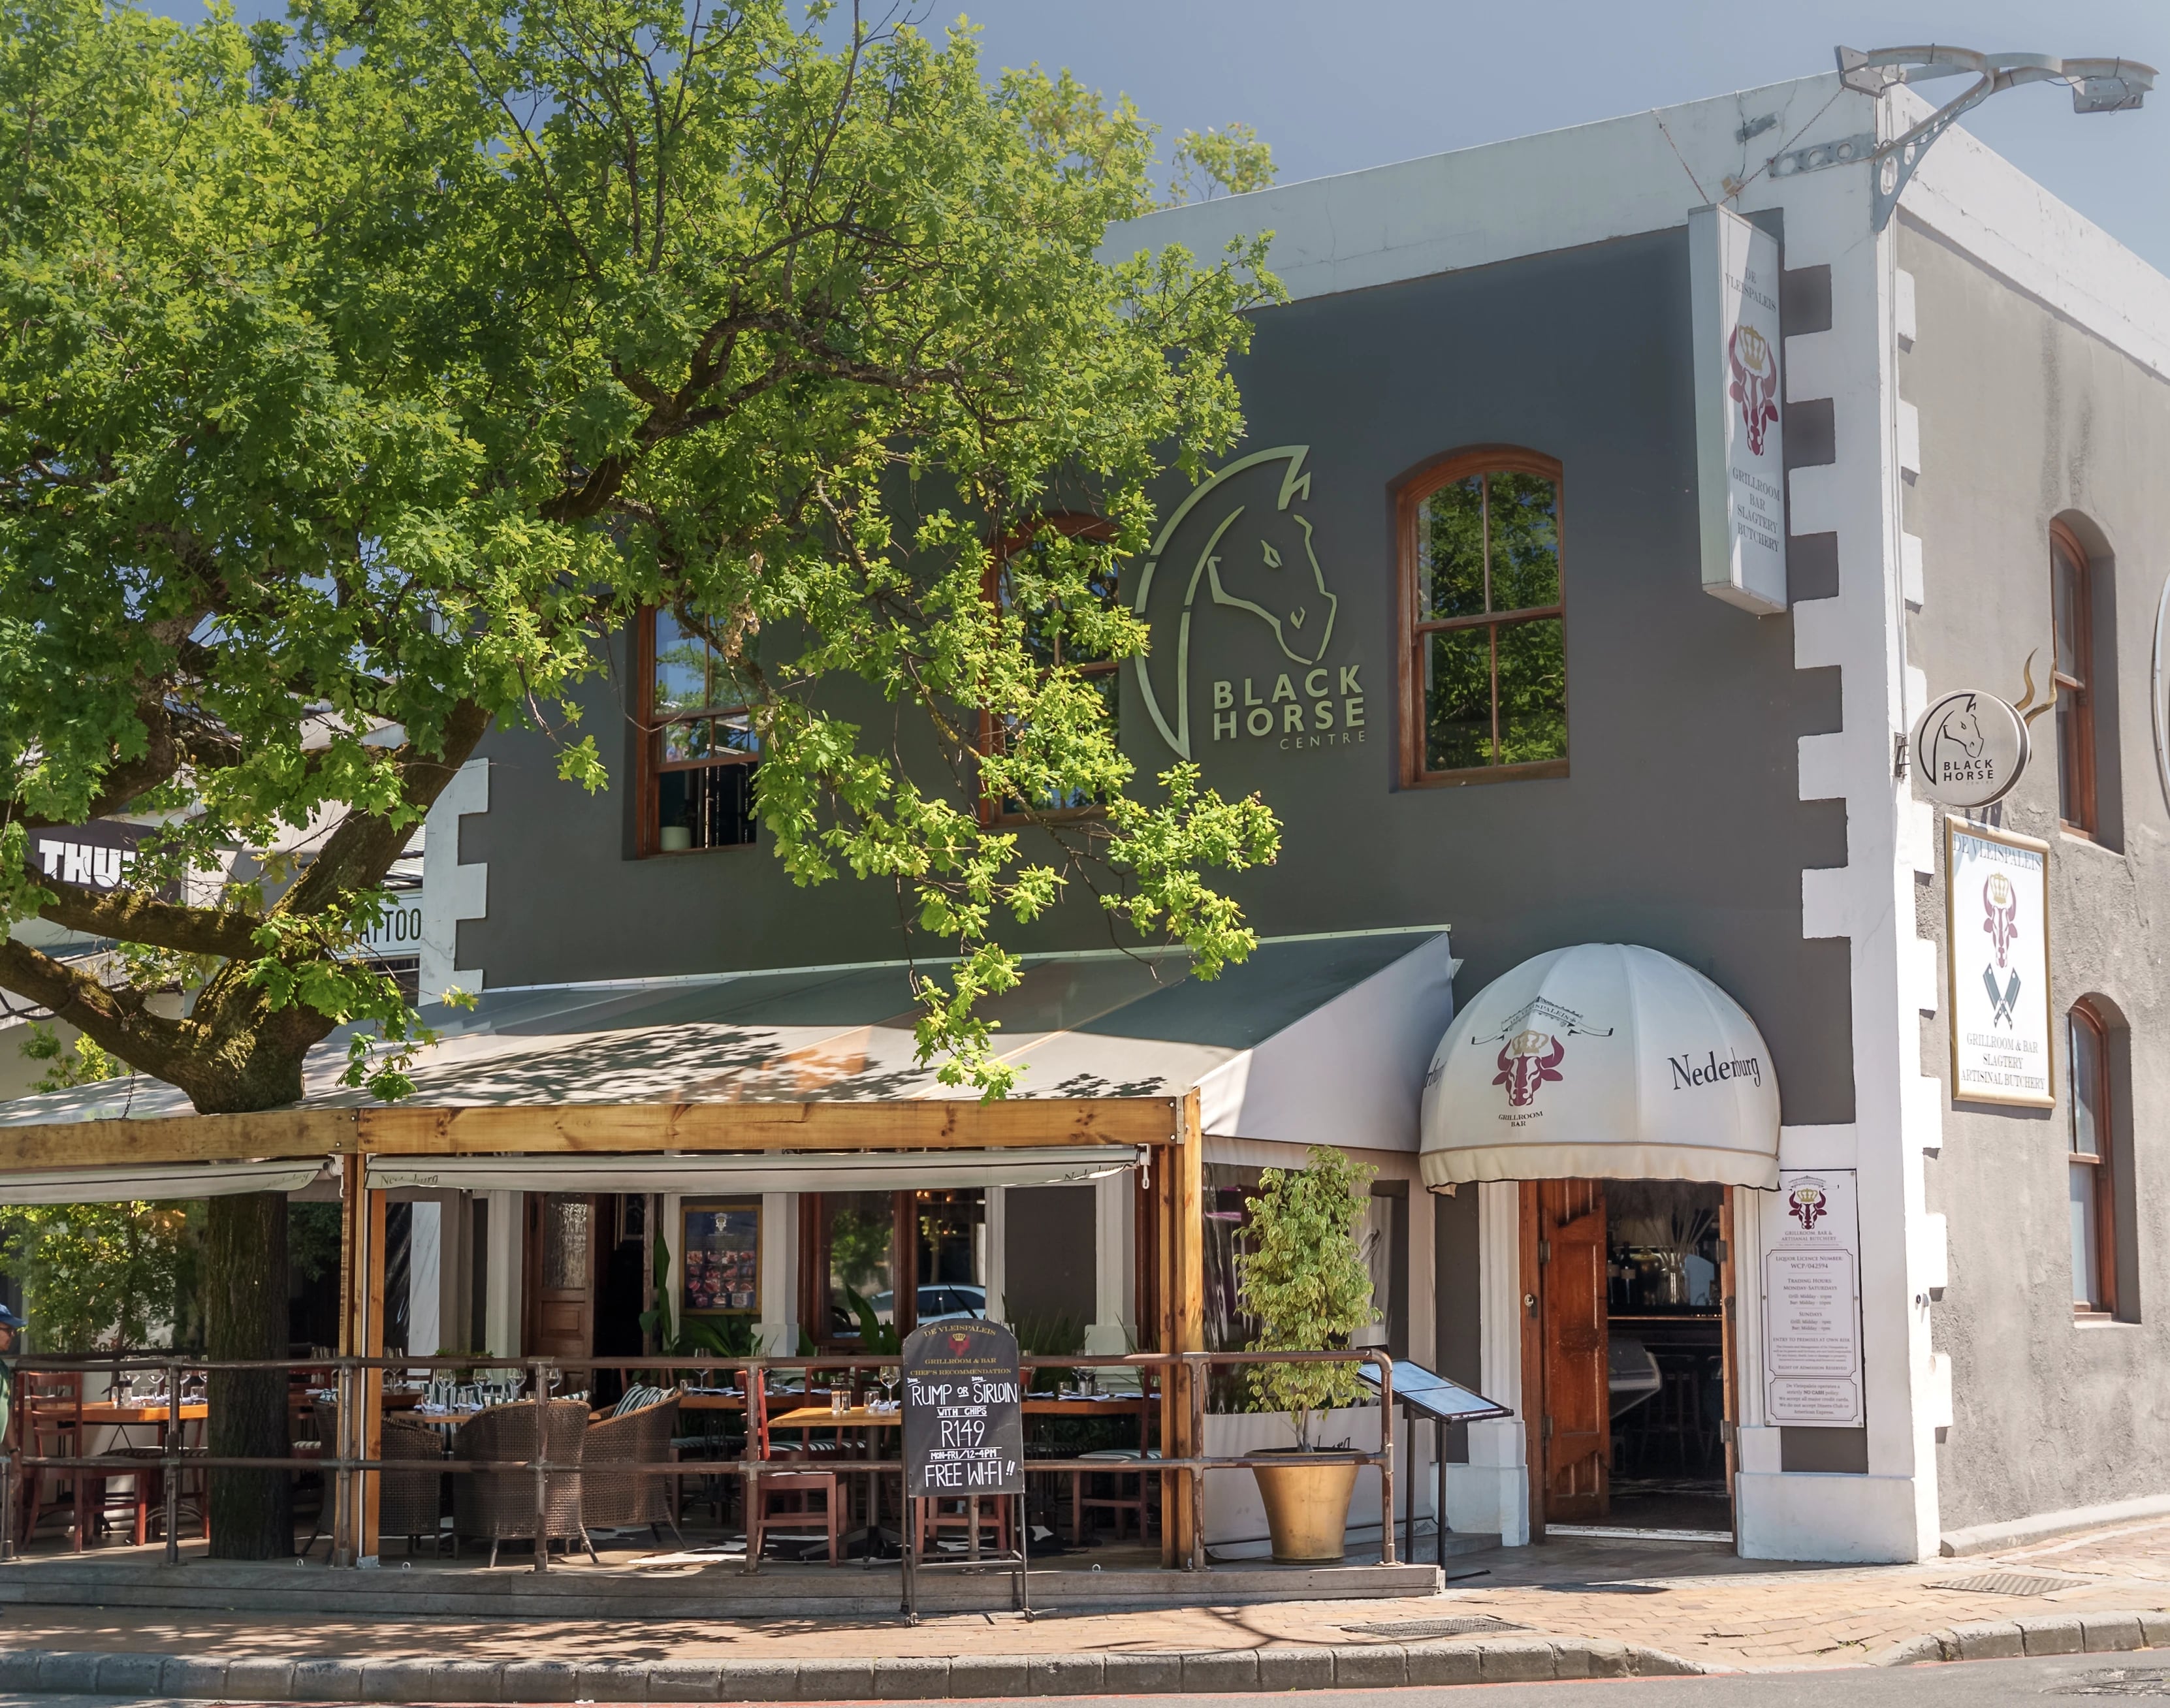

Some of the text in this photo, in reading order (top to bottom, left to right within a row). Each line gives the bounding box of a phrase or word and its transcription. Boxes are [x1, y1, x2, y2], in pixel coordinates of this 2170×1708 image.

[1745, 266, 1757, 283] DE
[1725, 272, 1776, 313] VLEISPALEIS
[1732, 467, 1780, 501] GRILLROOM
[1749, 494, 1765, 511] BAR
[1737, 505, 1778, 534] SLAGTERY
[1738, 522, 1779, 552] BUTCHERY
[1213, 665, 1363, 709] BLACK
[1213, 697, 1365, 741] HORSE
[1280, 731, 1365, 750] CENTRE
[1943, 770, 1994, 781] HORSE
[1944, 759, 1993, 770] BLACK
[1953, 834, 2041, 872] DE VLEISPALEIS
[1967, 1033, 2014, 1051] GRILLROOM
[2023, 1040, 2038, 1053] BAR
[1667, 1047, 1761, 1090] Nederburg
[1983, 1053, 2023, 1069] SLAGTERY
[2004, 1073, 2045, 1090] BUTCHERY
[1498, 1111, 1543, 1120] GRILLROOM
[938, 1325, 997, 1336] VLEISPALEIS
[912, 1384, 952, 1406] RUMP
[973, 1382, 1017, 1403] SIRLOIN
[941, 1419, 985, 1447] R149
[925, 1462, 963, 1487] FREE
[967, 1461, 1002, 1485] WI-FI
